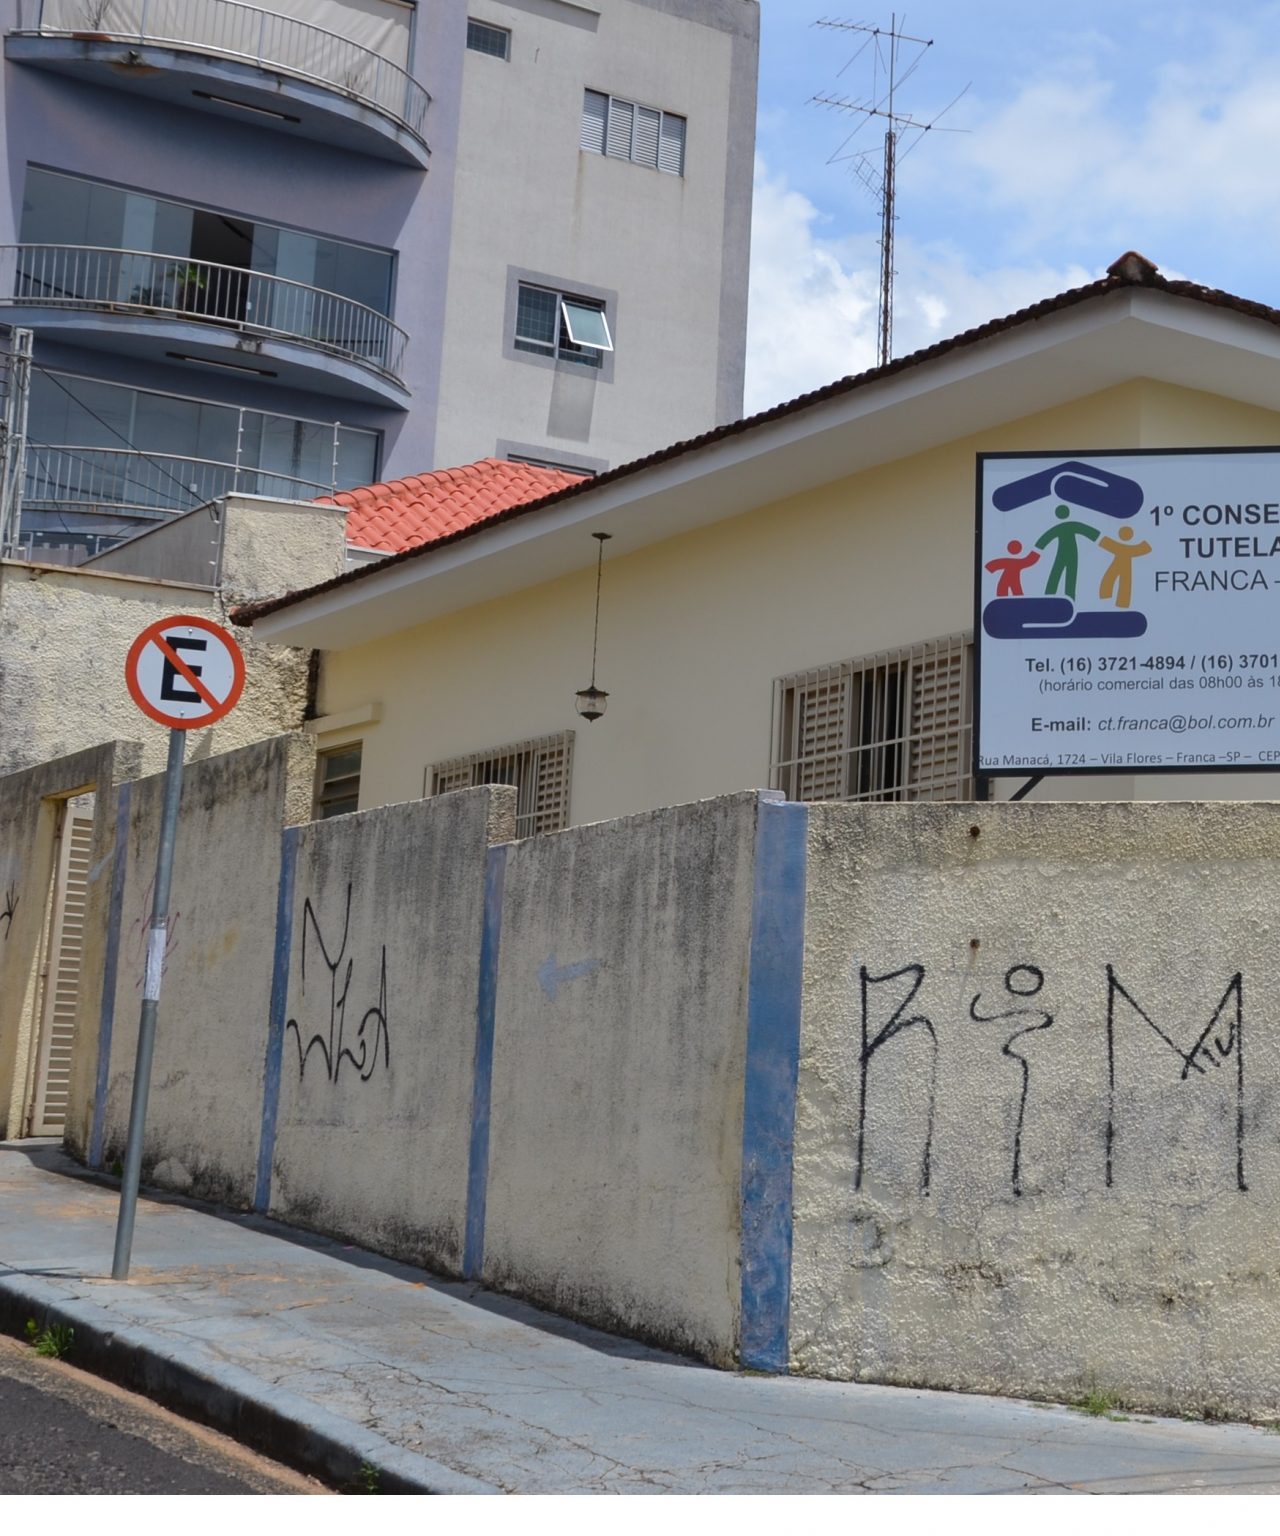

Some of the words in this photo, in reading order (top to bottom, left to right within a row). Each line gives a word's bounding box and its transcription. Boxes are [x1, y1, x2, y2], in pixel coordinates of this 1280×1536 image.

[1150, 505, 1174, 526] 1º
[1155, 569, 1268, 591] FRANCA
[160, 636, 207, 703] E
[1025, 658, 1054, 672] Tel.
[1060, 657, 1092, 675] (16)
[1098, 655, 1186, 671] 3721-4894
[1201, 654, 1233, 673] (16)
[1039, 678, 1092, 694] (horário
[1097, 677, 1164, 691] comercial
[1169, 677, 1194, 690] das
[1199, 675, 1242, 689] 08h00
[1247, 675, 1264, 688] às
[1031, 716, 1091, 732] E-mail:
[1098, 714, 1275, 734] ct.franca@bol.com.br
[977, 755, 999, 766] Rua
[1003, 753, 1053, 767] Manacá,
[1058, 753, 1086, 765] 1724
[1101, 753, 1123, 764] Vila
[1127, 752, 1162, 764] Flores
[1176, 752, 1215, 763] Franca
[1258, 750, 1280, 762] CEP
